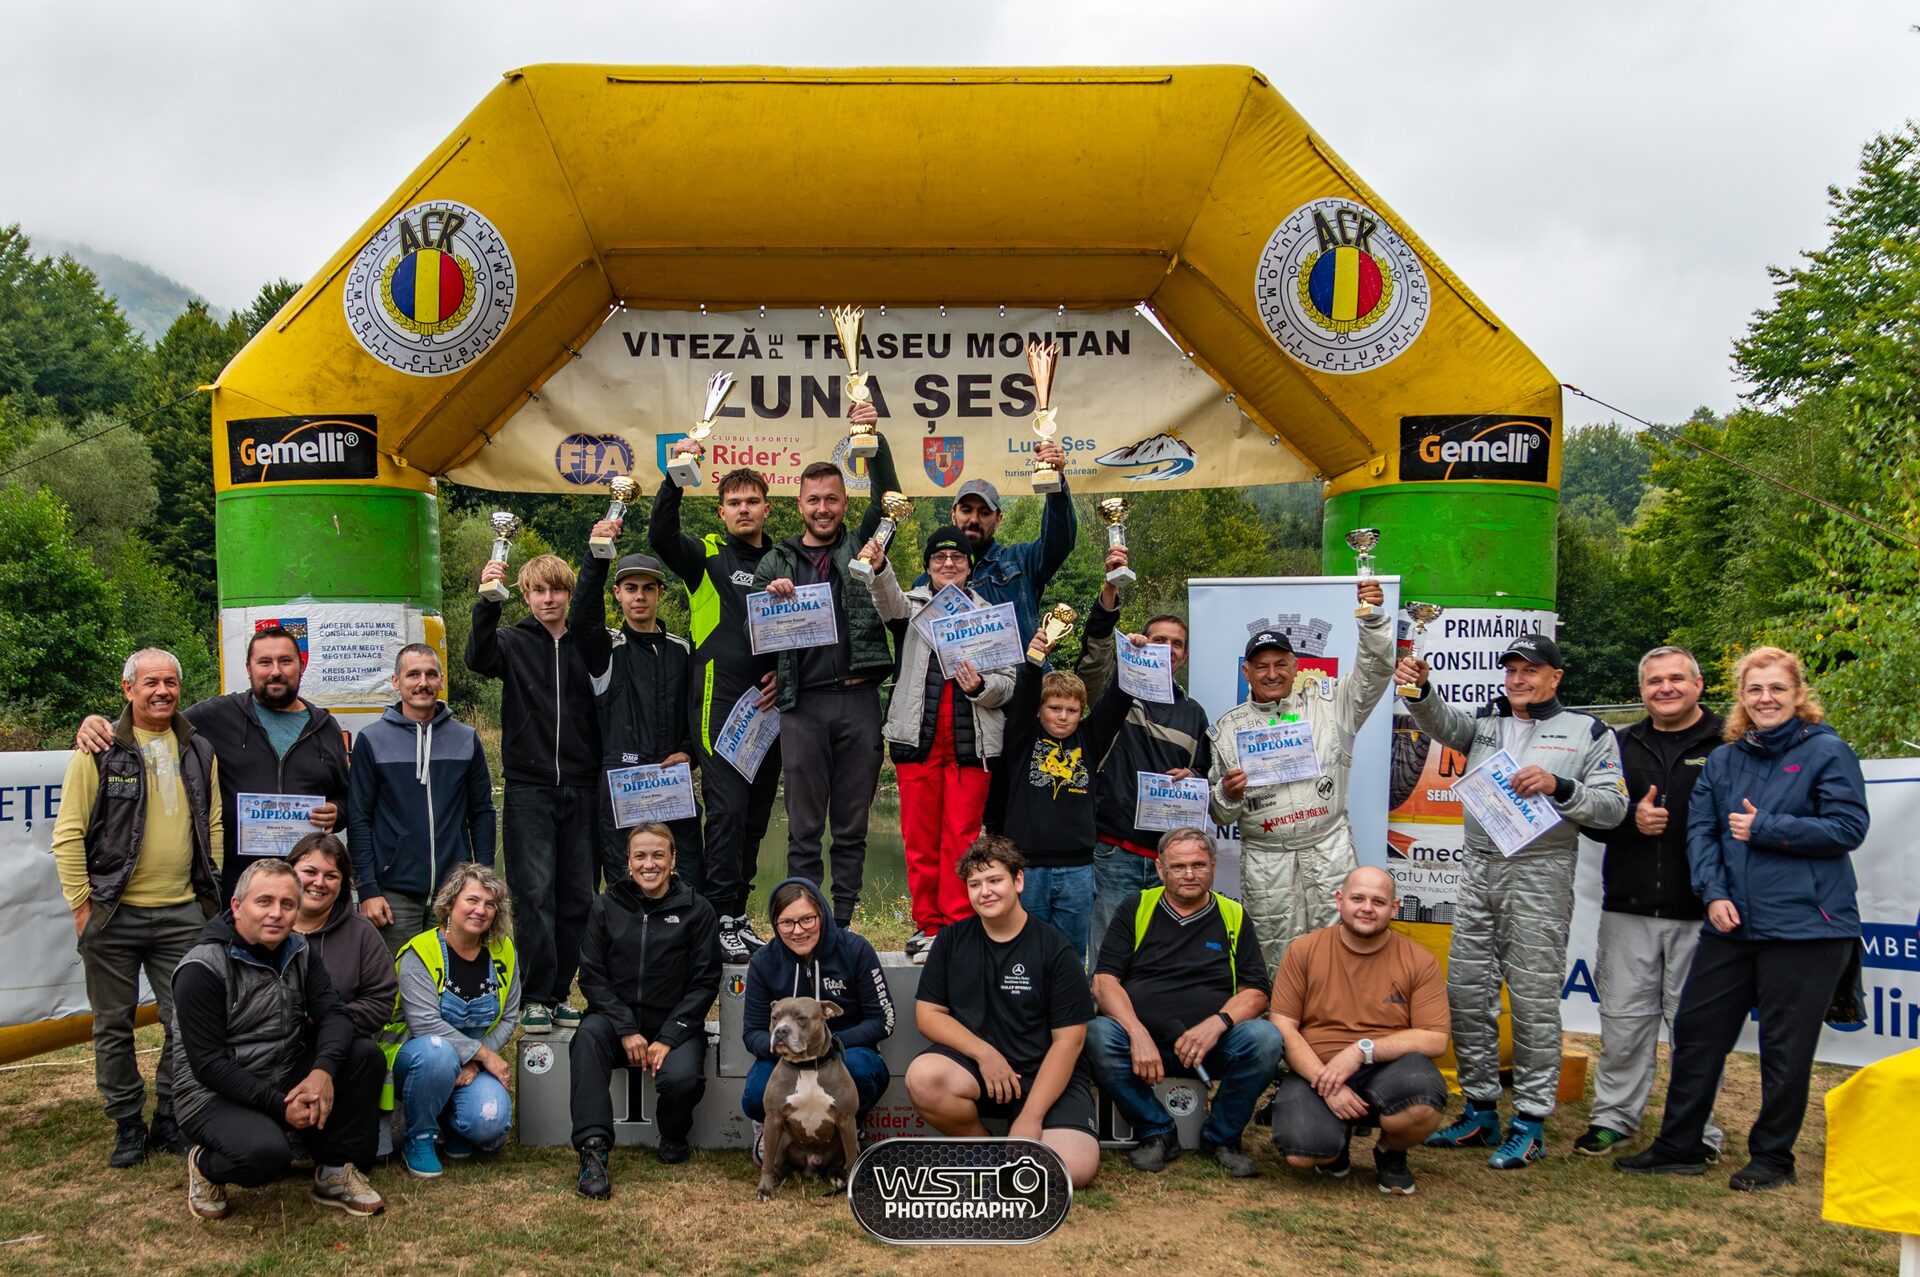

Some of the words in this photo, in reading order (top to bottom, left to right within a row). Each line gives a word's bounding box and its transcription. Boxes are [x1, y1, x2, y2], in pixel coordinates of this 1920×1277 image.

[353, 234, 388, 352] AUTOMOBIL
[412, 327, 493, 366] CLUBUL
[1266, 223, 1303, 350] AUTOMOBIL
[1325, 323, 1411, 363] CLUBUL
[622, 327, 763, 360] VITEZĂ
[768, 333, 784, 360] PE
[711, 434, 751, 442] CLUBUL
[712, 444, 802, 467] Rider's
[760, 600, 821, 617] DIPLOMA
[320, 630, 360, 638] CONSILIUL
[946, 621, 1005, 642] DIPLOMA
[1445, 615, 1529, 638] PRIMĂRIA
[346, 666, 382, 674] SATHMAR
[728, 704, 758, 753] DIPLOMA
[1247, 736, 1304, 754] DIPLOMA
[623, 776, 680, 793] DIPLOMA
[1149, 787, 1199, 801] DIPLOMA
[1491, 769, 1538, 825] DIPLOMA
[251, 809, 311, 821] DIPLOMA
[1388, 867, 1423, 884] Satu
